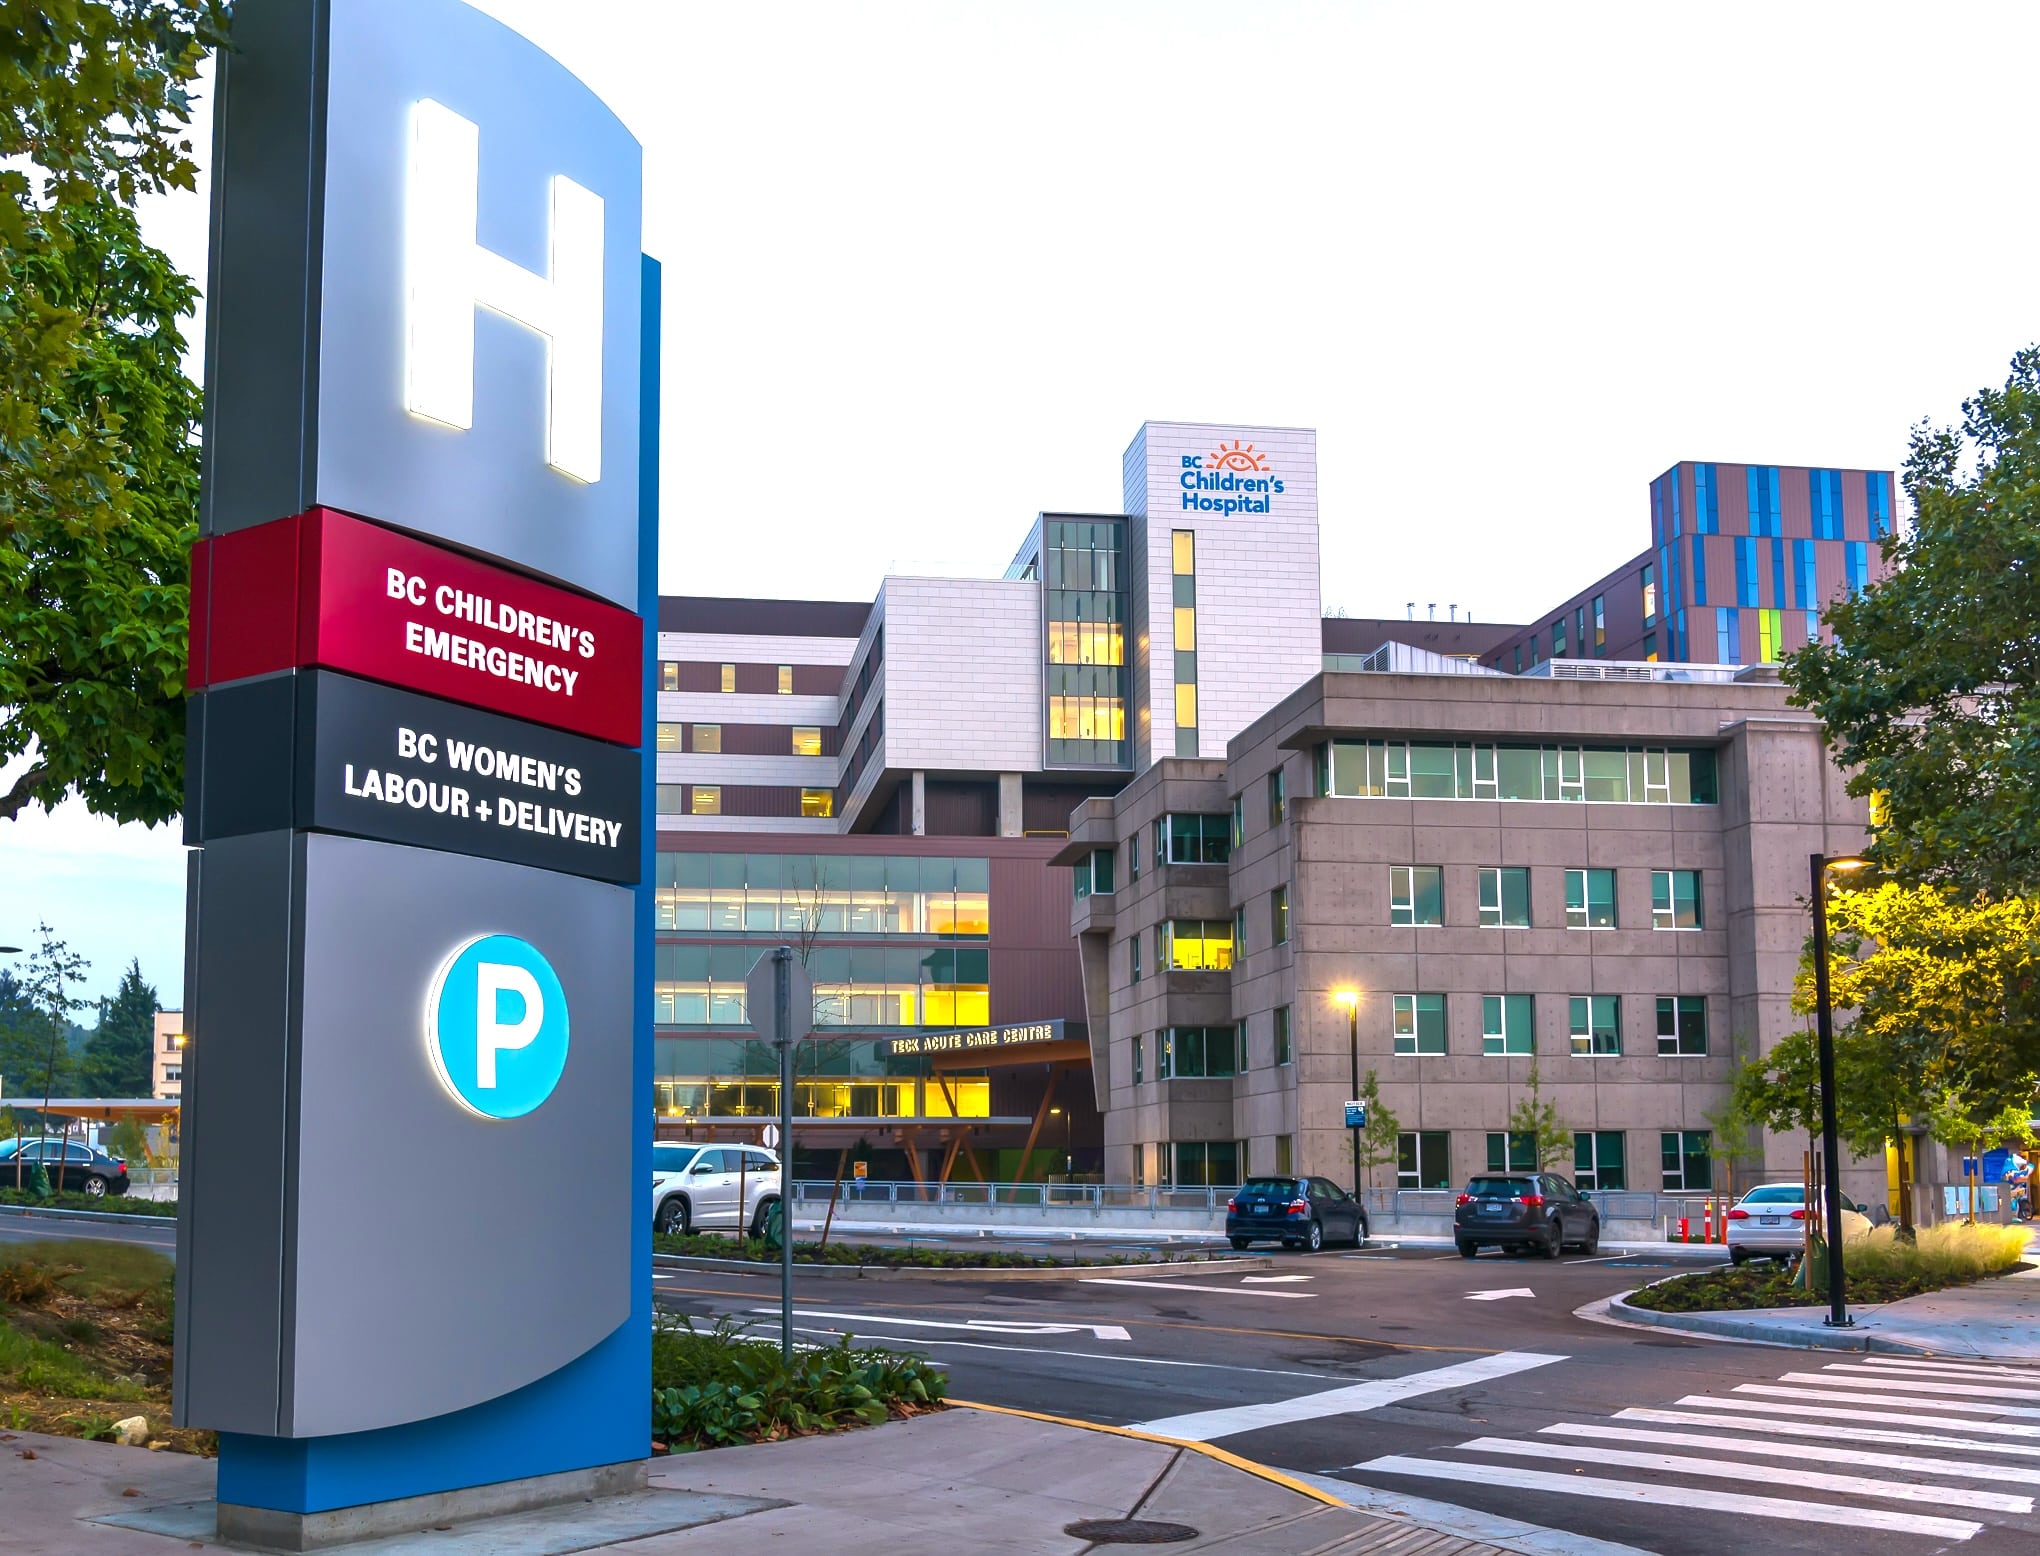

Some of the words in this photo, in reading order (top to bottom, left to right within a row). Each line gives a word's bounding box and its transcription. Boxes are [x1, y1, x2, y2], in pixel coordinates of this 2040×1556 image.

[410, 97, 605, 485] H
[1180, 470, 1285, 494] Children's
[1181, 455, 1202, 469] BC
[1182, 492, 1270, 517] Hospital
[387, 567, 427, 606] BC
[435, 585, 596, 659] CHILDREN'S
[405, 621, 579, 697] EMERGENCY
[398, 727, 438, 764] BC
[446, 738, 582, 796] WOMEN'S
[344, 764, 470, 818] LABOUR
[498, 797, 623, 848] DELIVERY
[476, 961, 545, 1089] P
[890, 1038, 920, 1054] TECK
[924, 1034, 962, 1051] ACUTE
[966, 1030, 998, 1047] CARE
[1003, 1024, 1052, 1044] CENTRE
